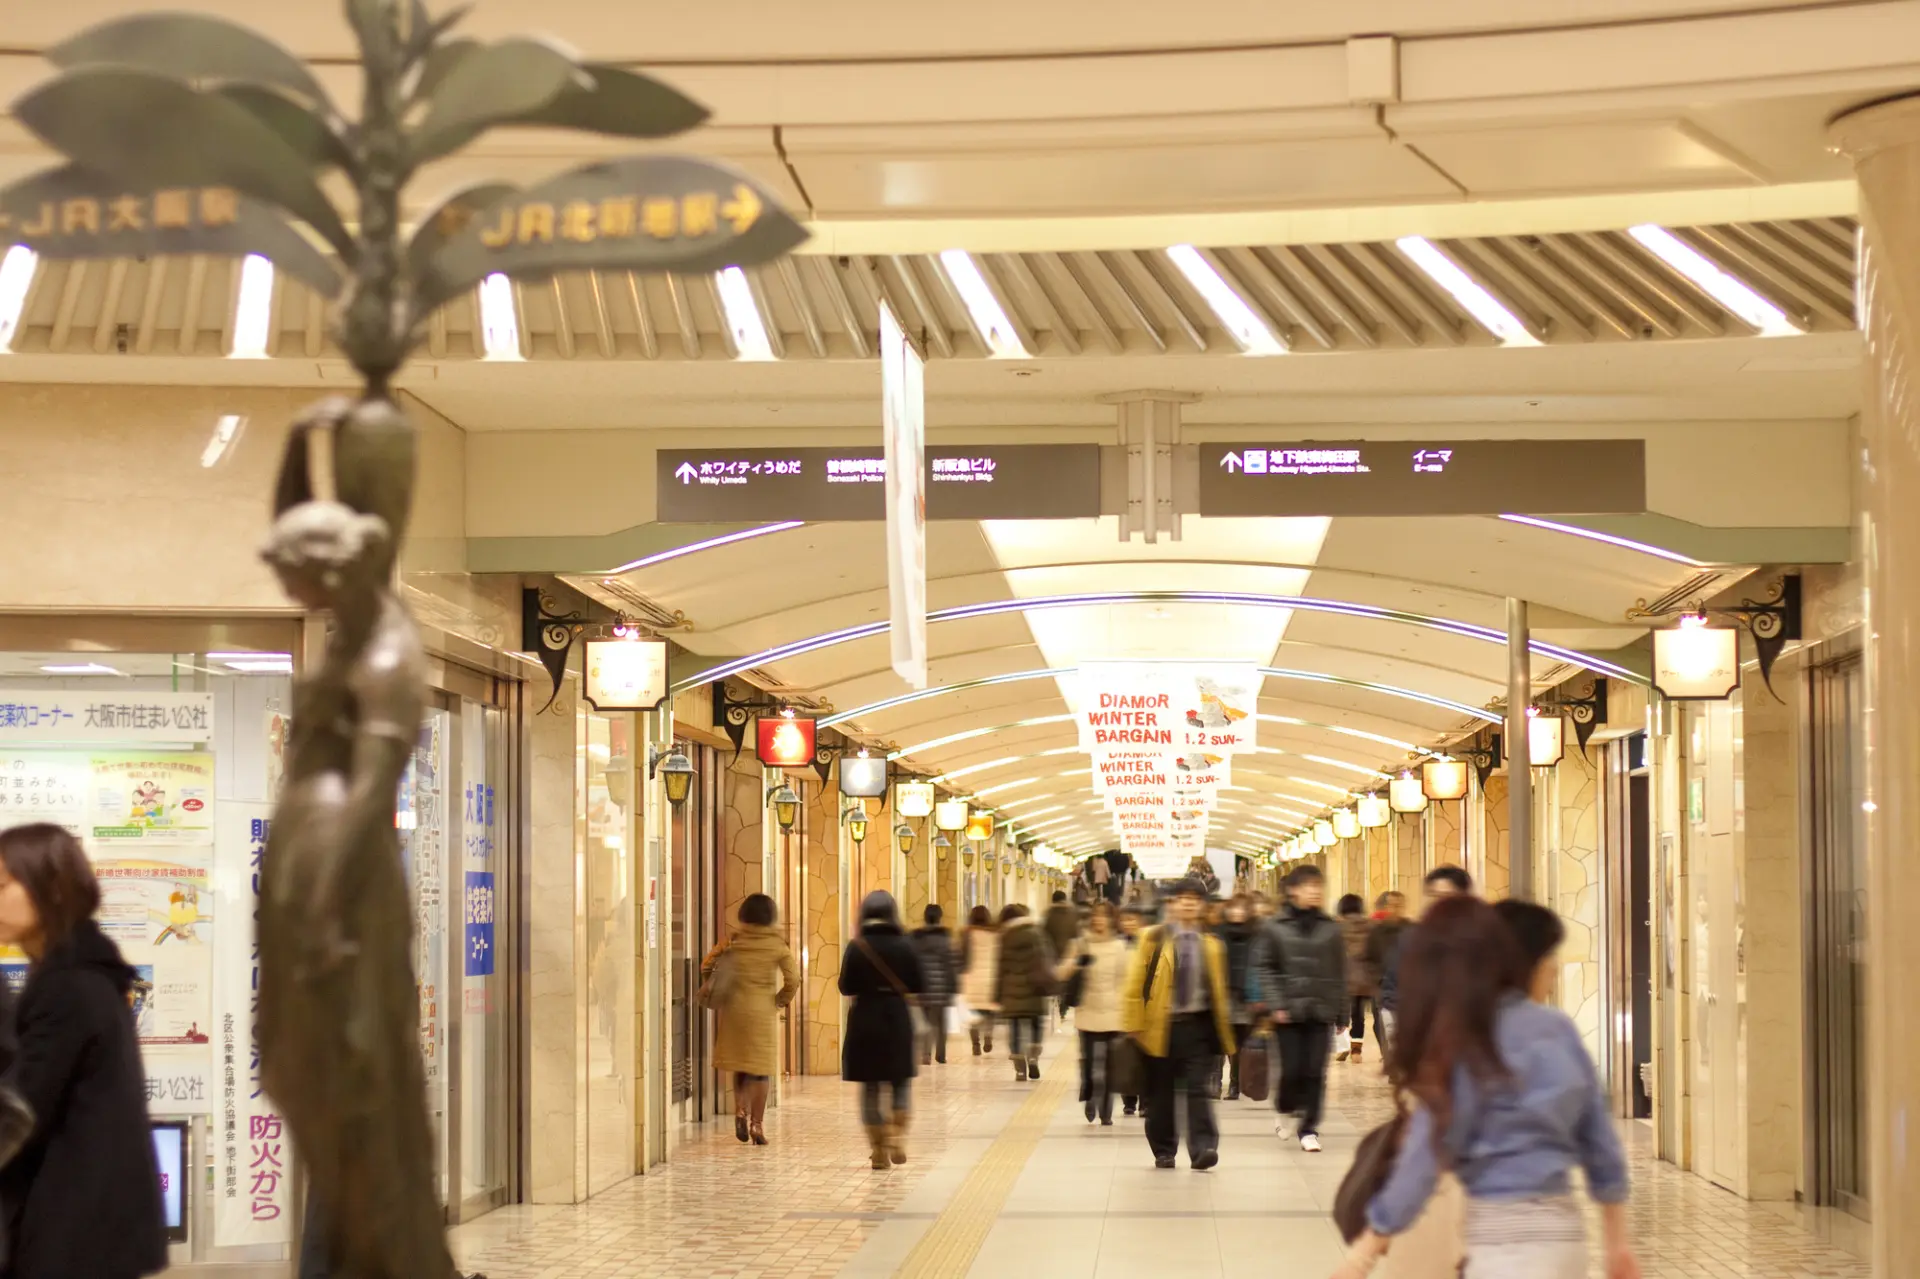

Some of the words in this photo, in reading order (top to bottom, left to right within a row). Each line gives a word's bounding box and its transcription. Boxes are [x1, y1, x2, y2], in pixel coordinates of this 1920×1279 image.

[1413, 449, 1453, 462] イーマ
[700, 460, 802, 474] ホワイティうめだ
[1100, 693, 1169, 709] DIAMOR
[84, 704, 208, 729] 大阪市住まい公社
[1088, 712, 1158, 726] WINTER
[1095, 729, 1172, 744] BARGAIN
[1100, 761, 1153, 772] WINTER
[1106, 774, 1166, 786] BARGAIN
[465, 781, 495, 828] 大阪市
[1115, 796, 1164, 806] BARGAIN
[1119, 812, 1156, 820] WINTER
[1122, 822, 1164, 830] BARGAIN
[467, 885, 493, 924] 住宅案内
[249, 1113, 283, 1222] 防火から
